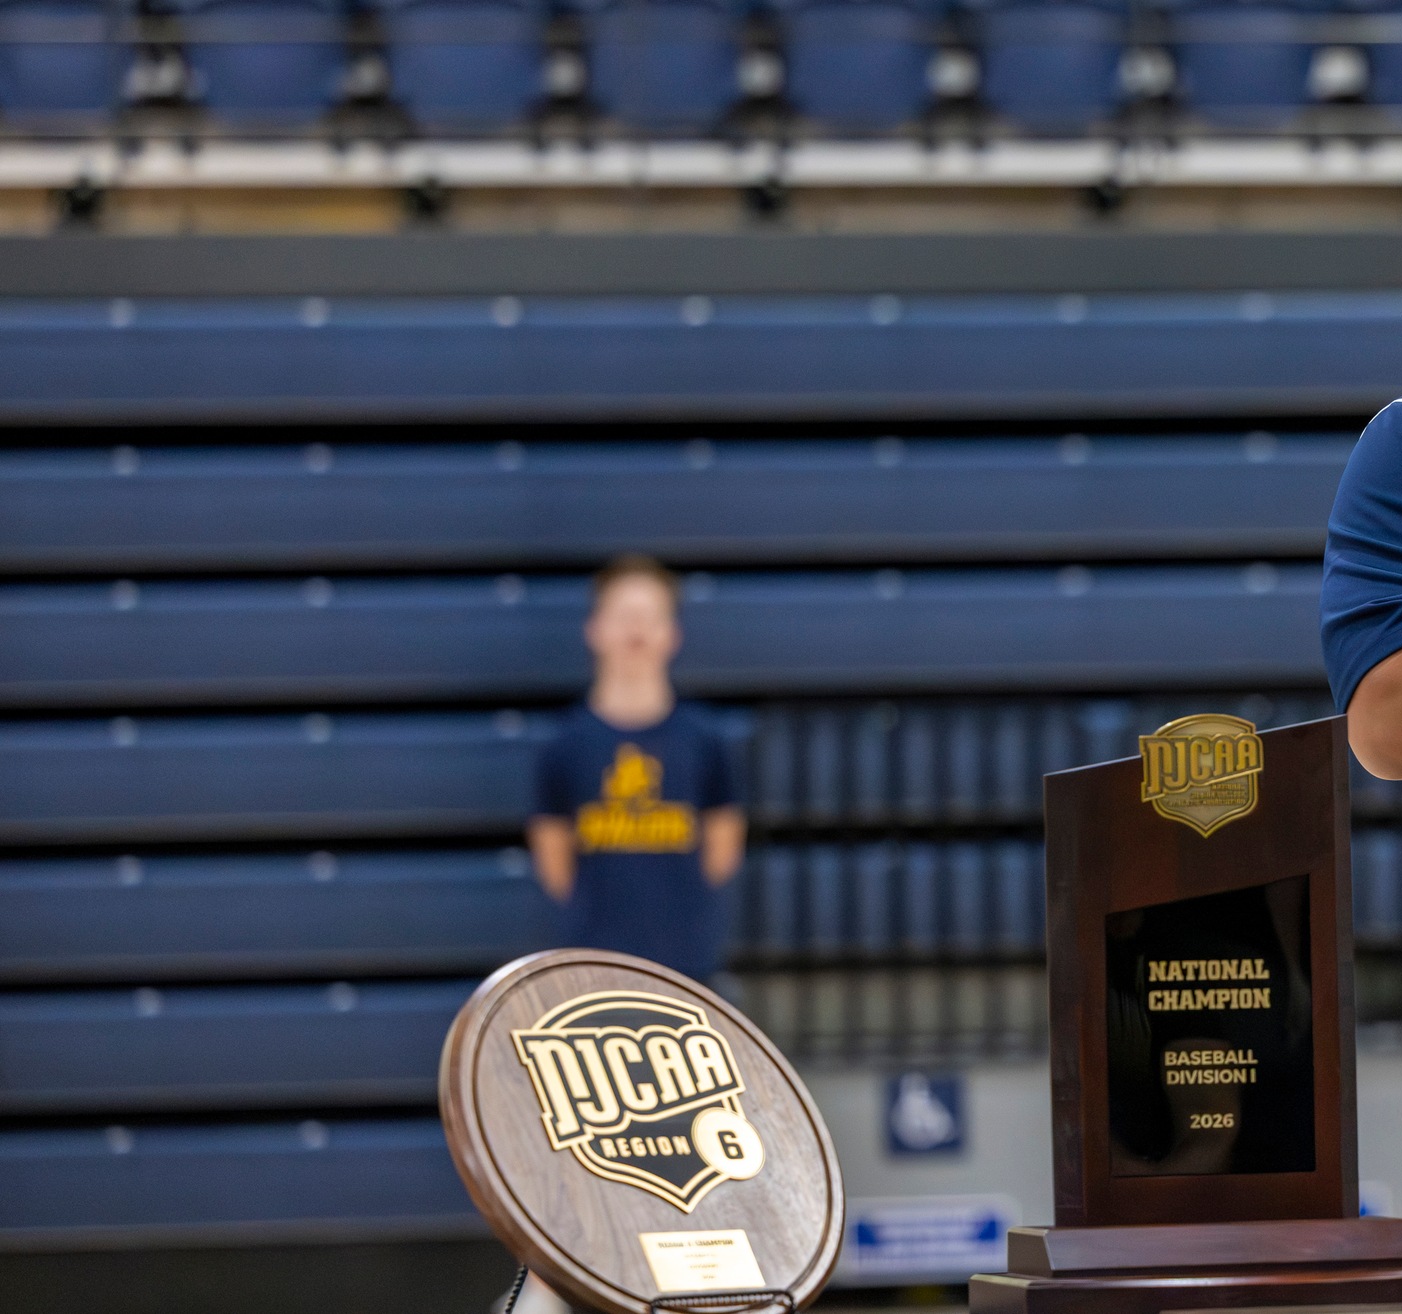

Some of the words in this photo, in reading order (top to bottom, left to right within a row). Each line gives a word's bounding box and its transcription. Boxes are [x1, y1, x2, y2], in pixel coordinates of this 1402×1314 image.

[1147, 739, 1258, 794] NJCAA
[1148, 959, 1270, 981] NATIONAL
[1148, 988, 1271, 1011] CHAMPION
[1164, 1049, 1258, 1066] BASEBALL
[526, 1034, 732, 1137] NJCAA
[1166, 1069, 1247, 1085] DIVISION
[1250, 1068, 1257, 1083] I
[1190, 1113, 1235, 1129] 2026
[600, 1135, 692, 1159] REGION
[717, 1130, 744, 1159] 6
